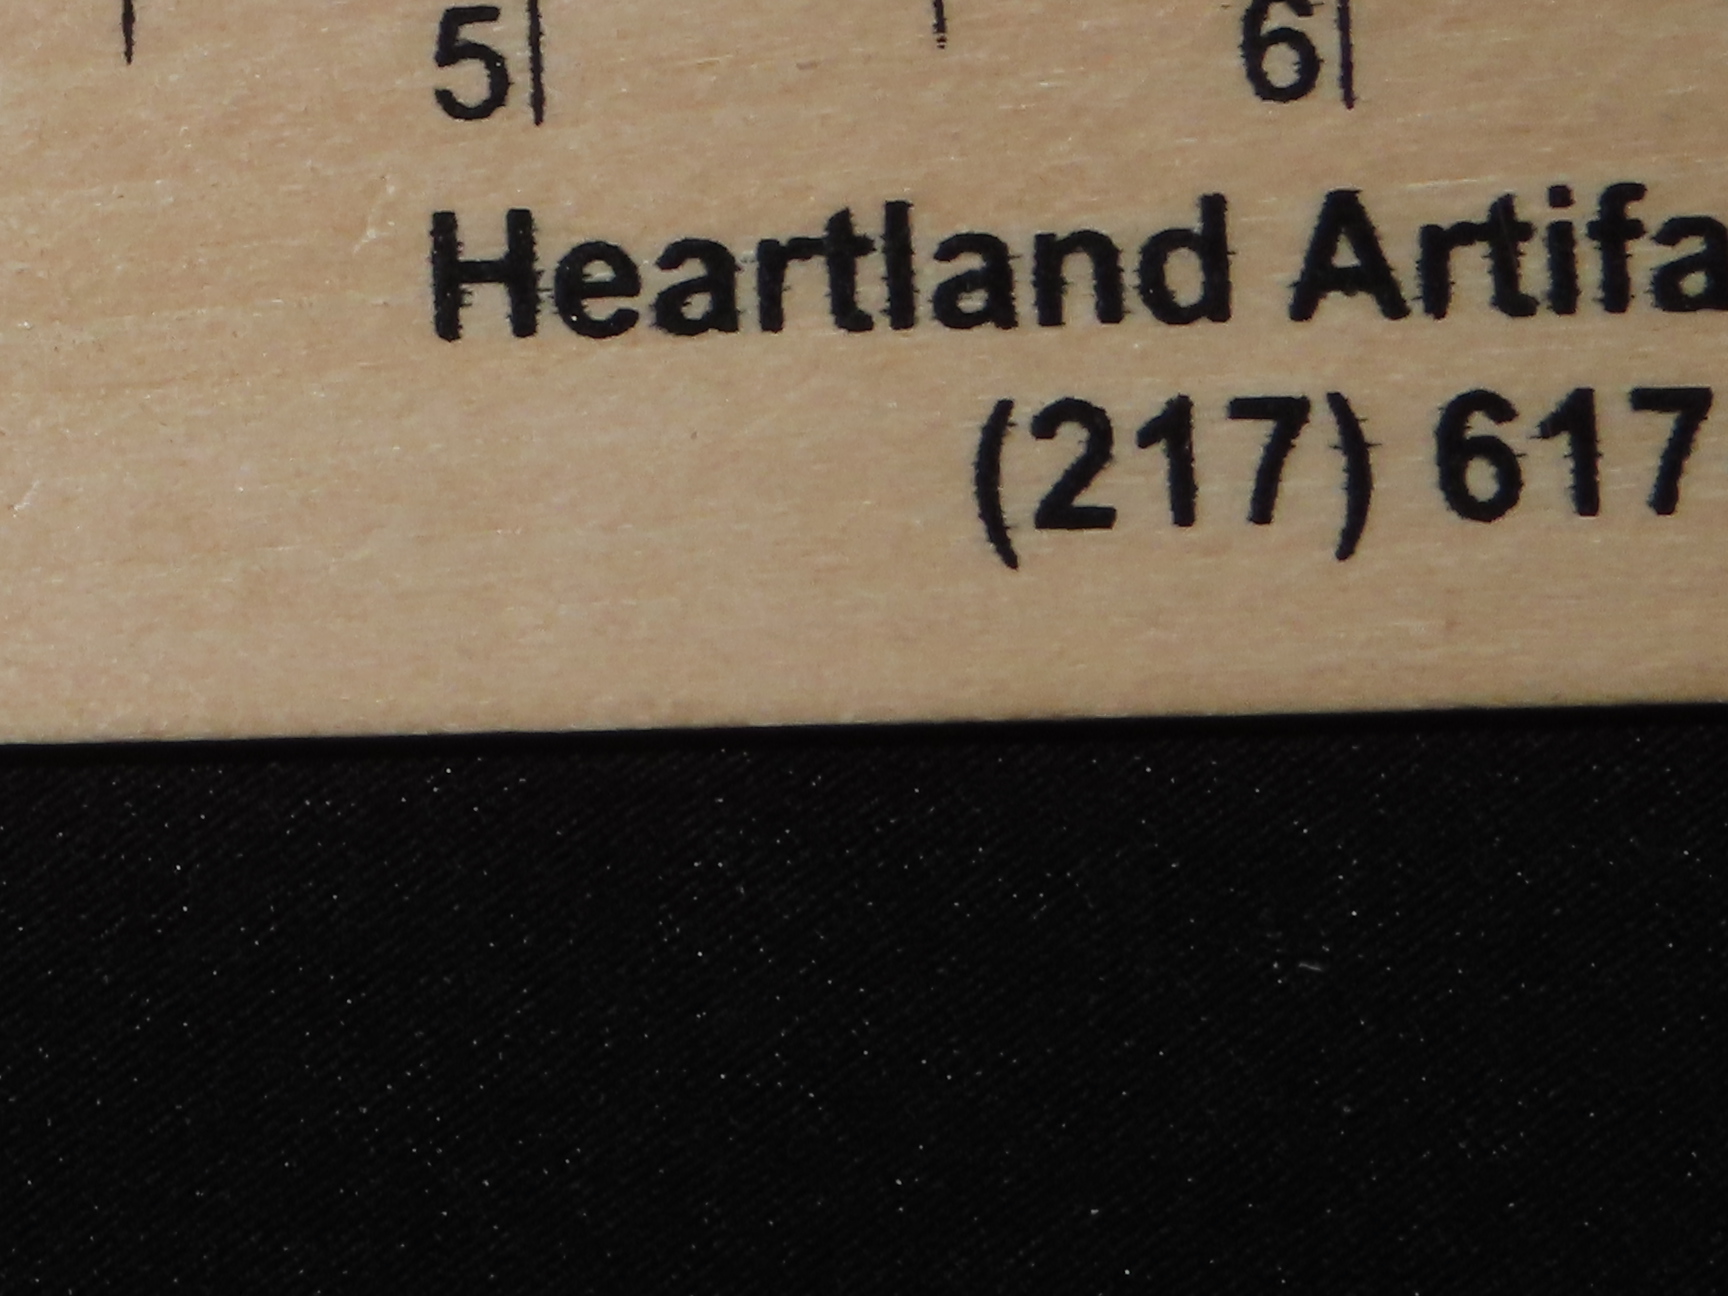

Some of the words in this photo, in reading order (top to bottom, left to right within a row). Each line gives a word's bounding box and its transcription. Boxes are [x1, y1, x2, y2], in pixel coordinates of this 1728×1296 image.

[433, 4, 515, 123] 5
[428, 191, 1238, 344] Heartland
[1287, 180, 1728, 324] Artifa
[972, 390, 1379, 572] (217)
[1432, 385, 1715, 525] 617
